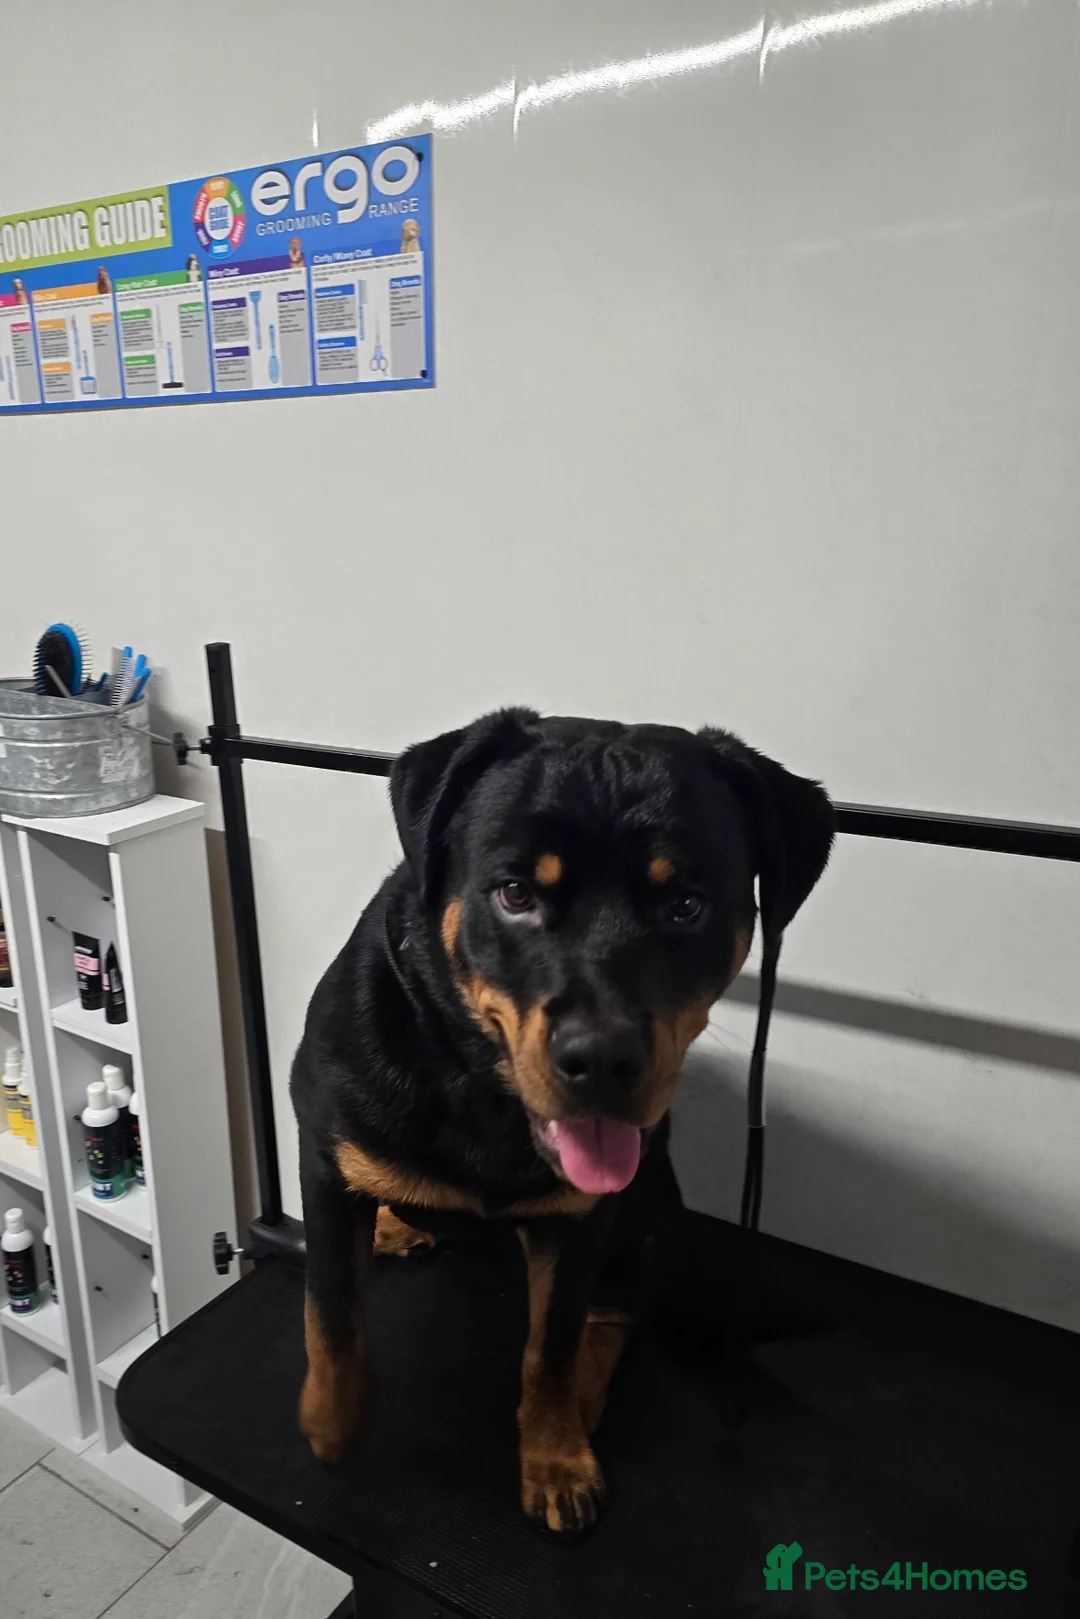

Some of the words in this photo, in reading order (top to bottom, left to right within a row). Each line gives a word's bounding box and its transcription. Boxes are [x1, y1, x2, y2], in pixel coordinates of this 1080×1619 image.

[251, 146, 420, 224] ergo
[94, 196, 167, 248] GUIDE
[256, 212, 332, 236] GROOMING
[368, 198, 419, 218] RANGE
